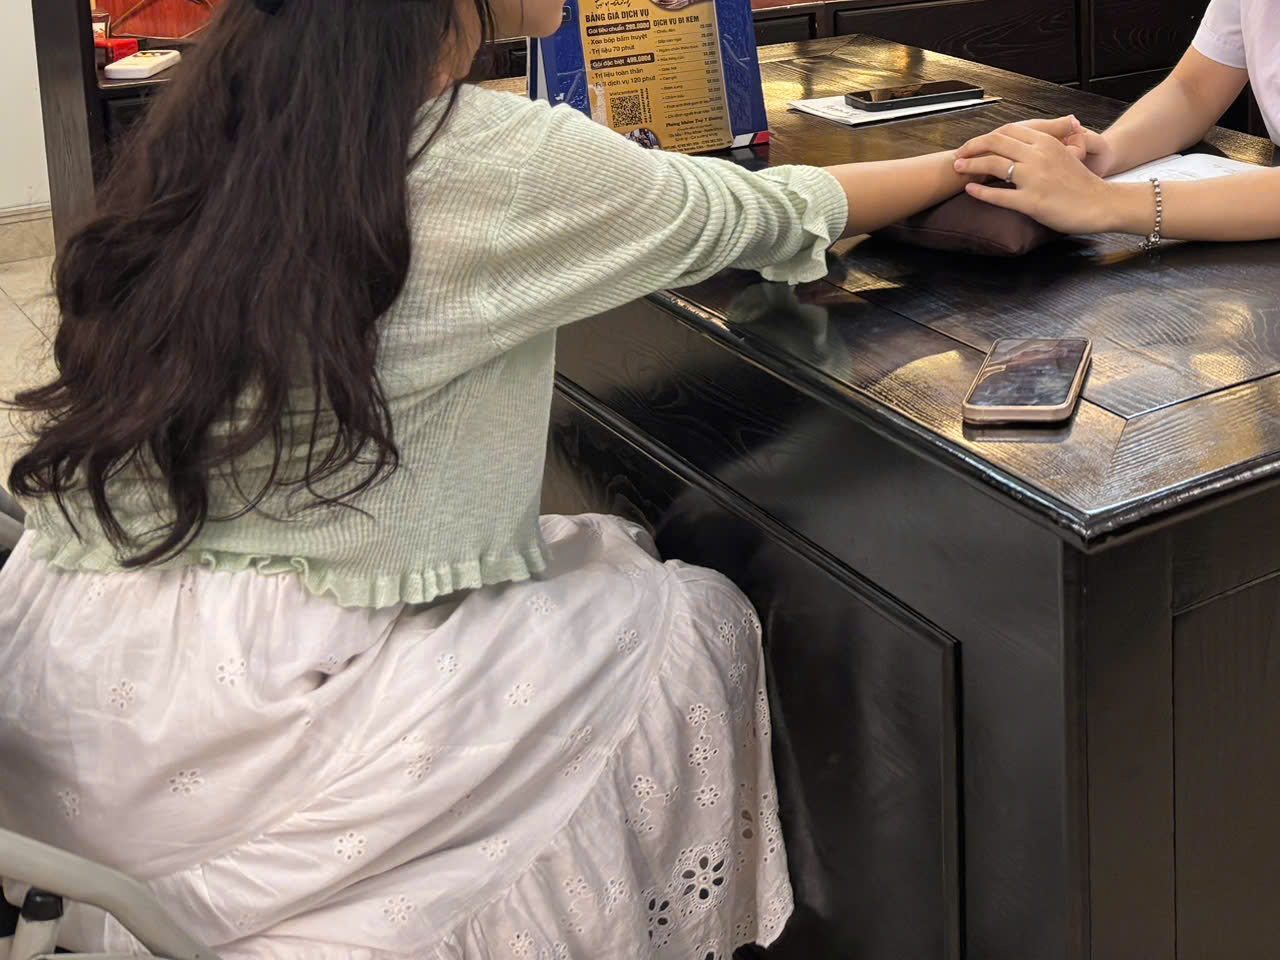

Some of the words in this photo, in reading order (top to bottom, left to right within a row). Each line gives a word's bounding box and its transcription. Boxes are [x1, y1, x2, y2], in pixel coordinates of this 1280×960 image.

[585, 12, 605, 23] BẢNG
[621, 10, 638, 20] DỊCH
[639, 9, 649, 19] VỤ
